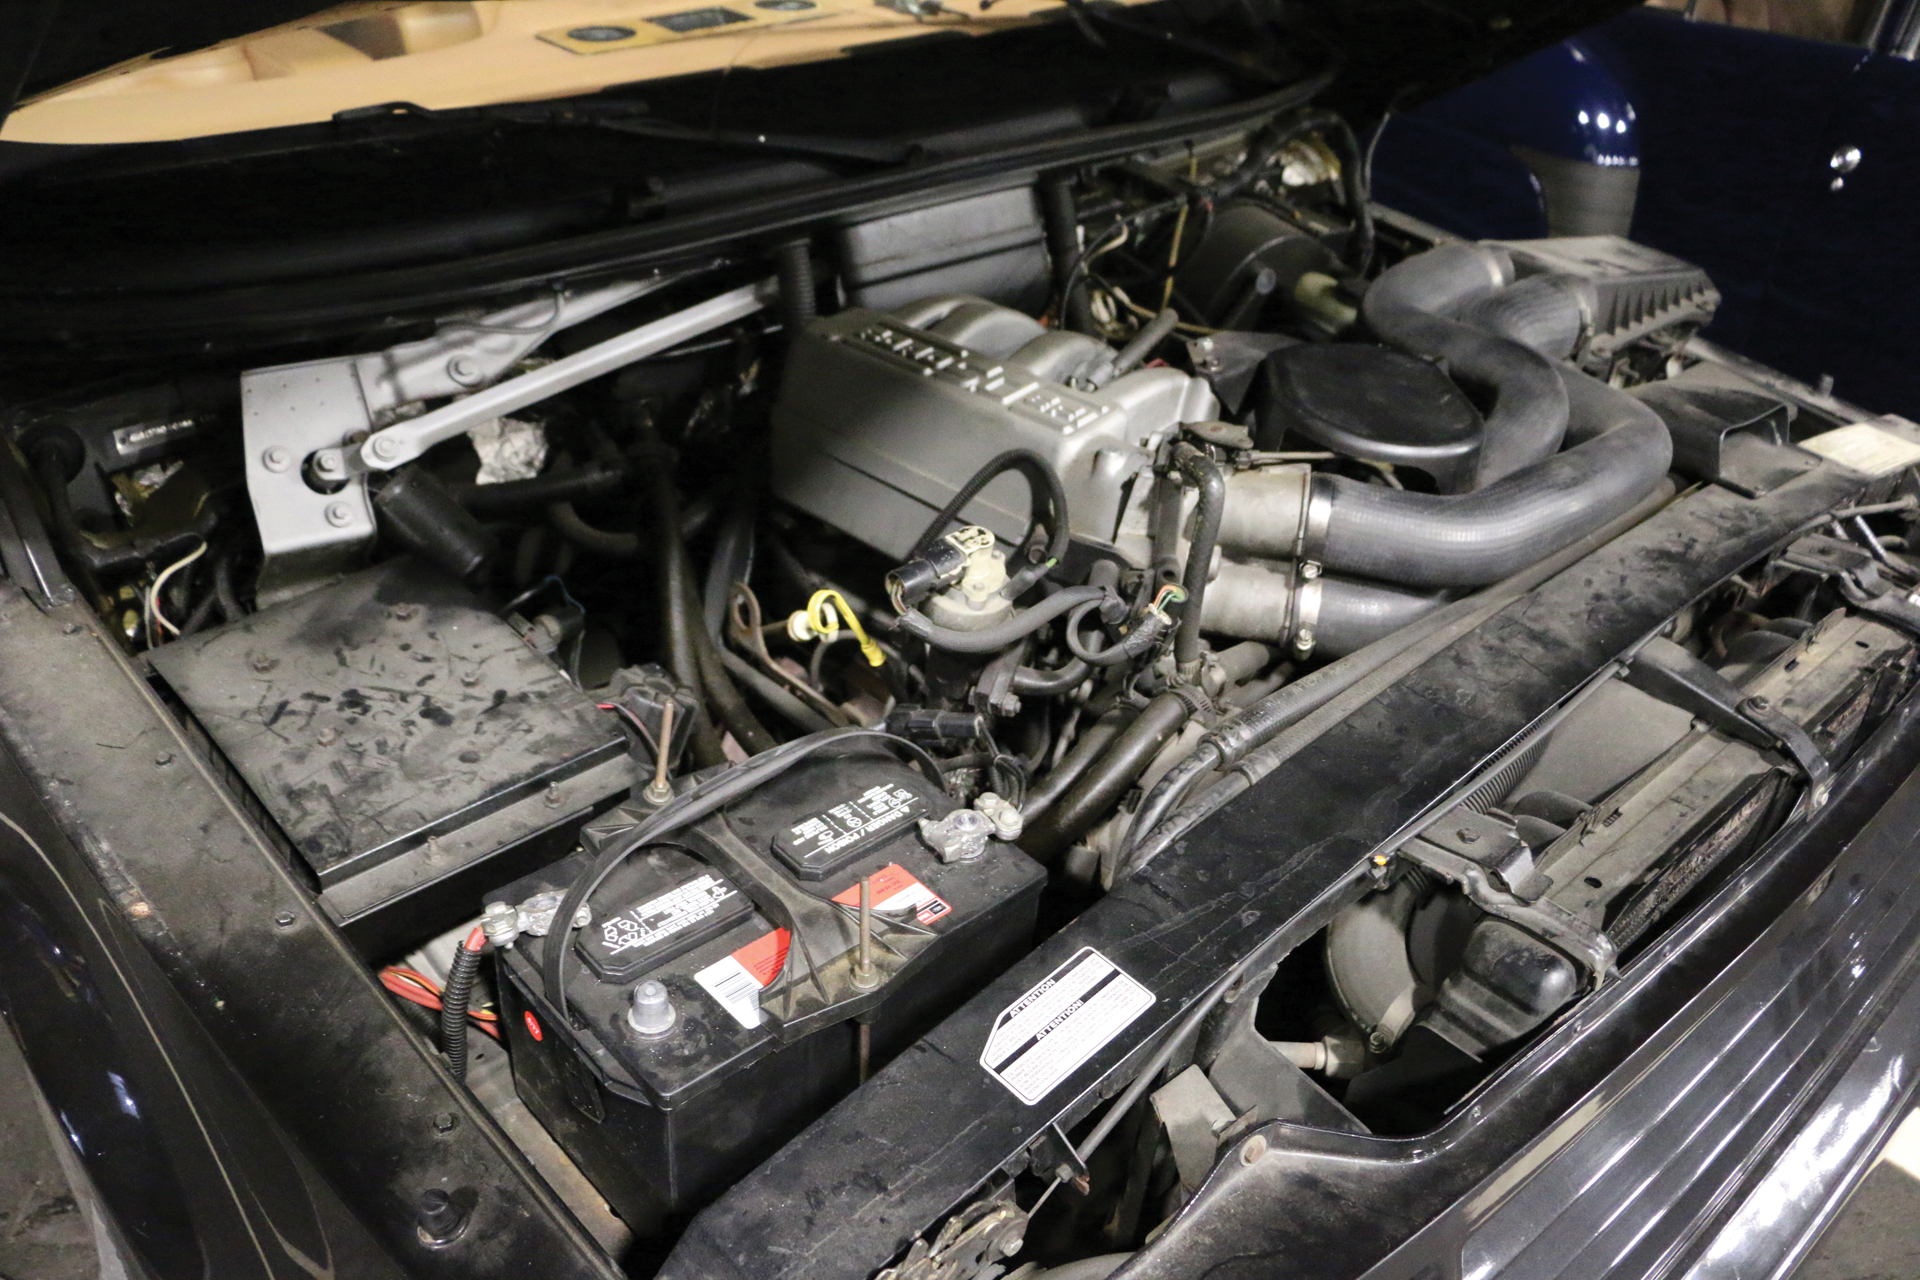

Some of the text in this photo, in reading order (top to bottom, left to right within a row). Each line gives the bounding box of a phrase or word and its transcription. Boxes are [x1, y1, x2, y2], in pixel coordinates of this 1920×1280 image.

[866, 811, 903, 832] DANGER
[825, 833, 861, 854] POISON
[1009, 979, 1055, 1017] ATTENTION
[1036, 1000, 1084, 1041] ATTENTION!
